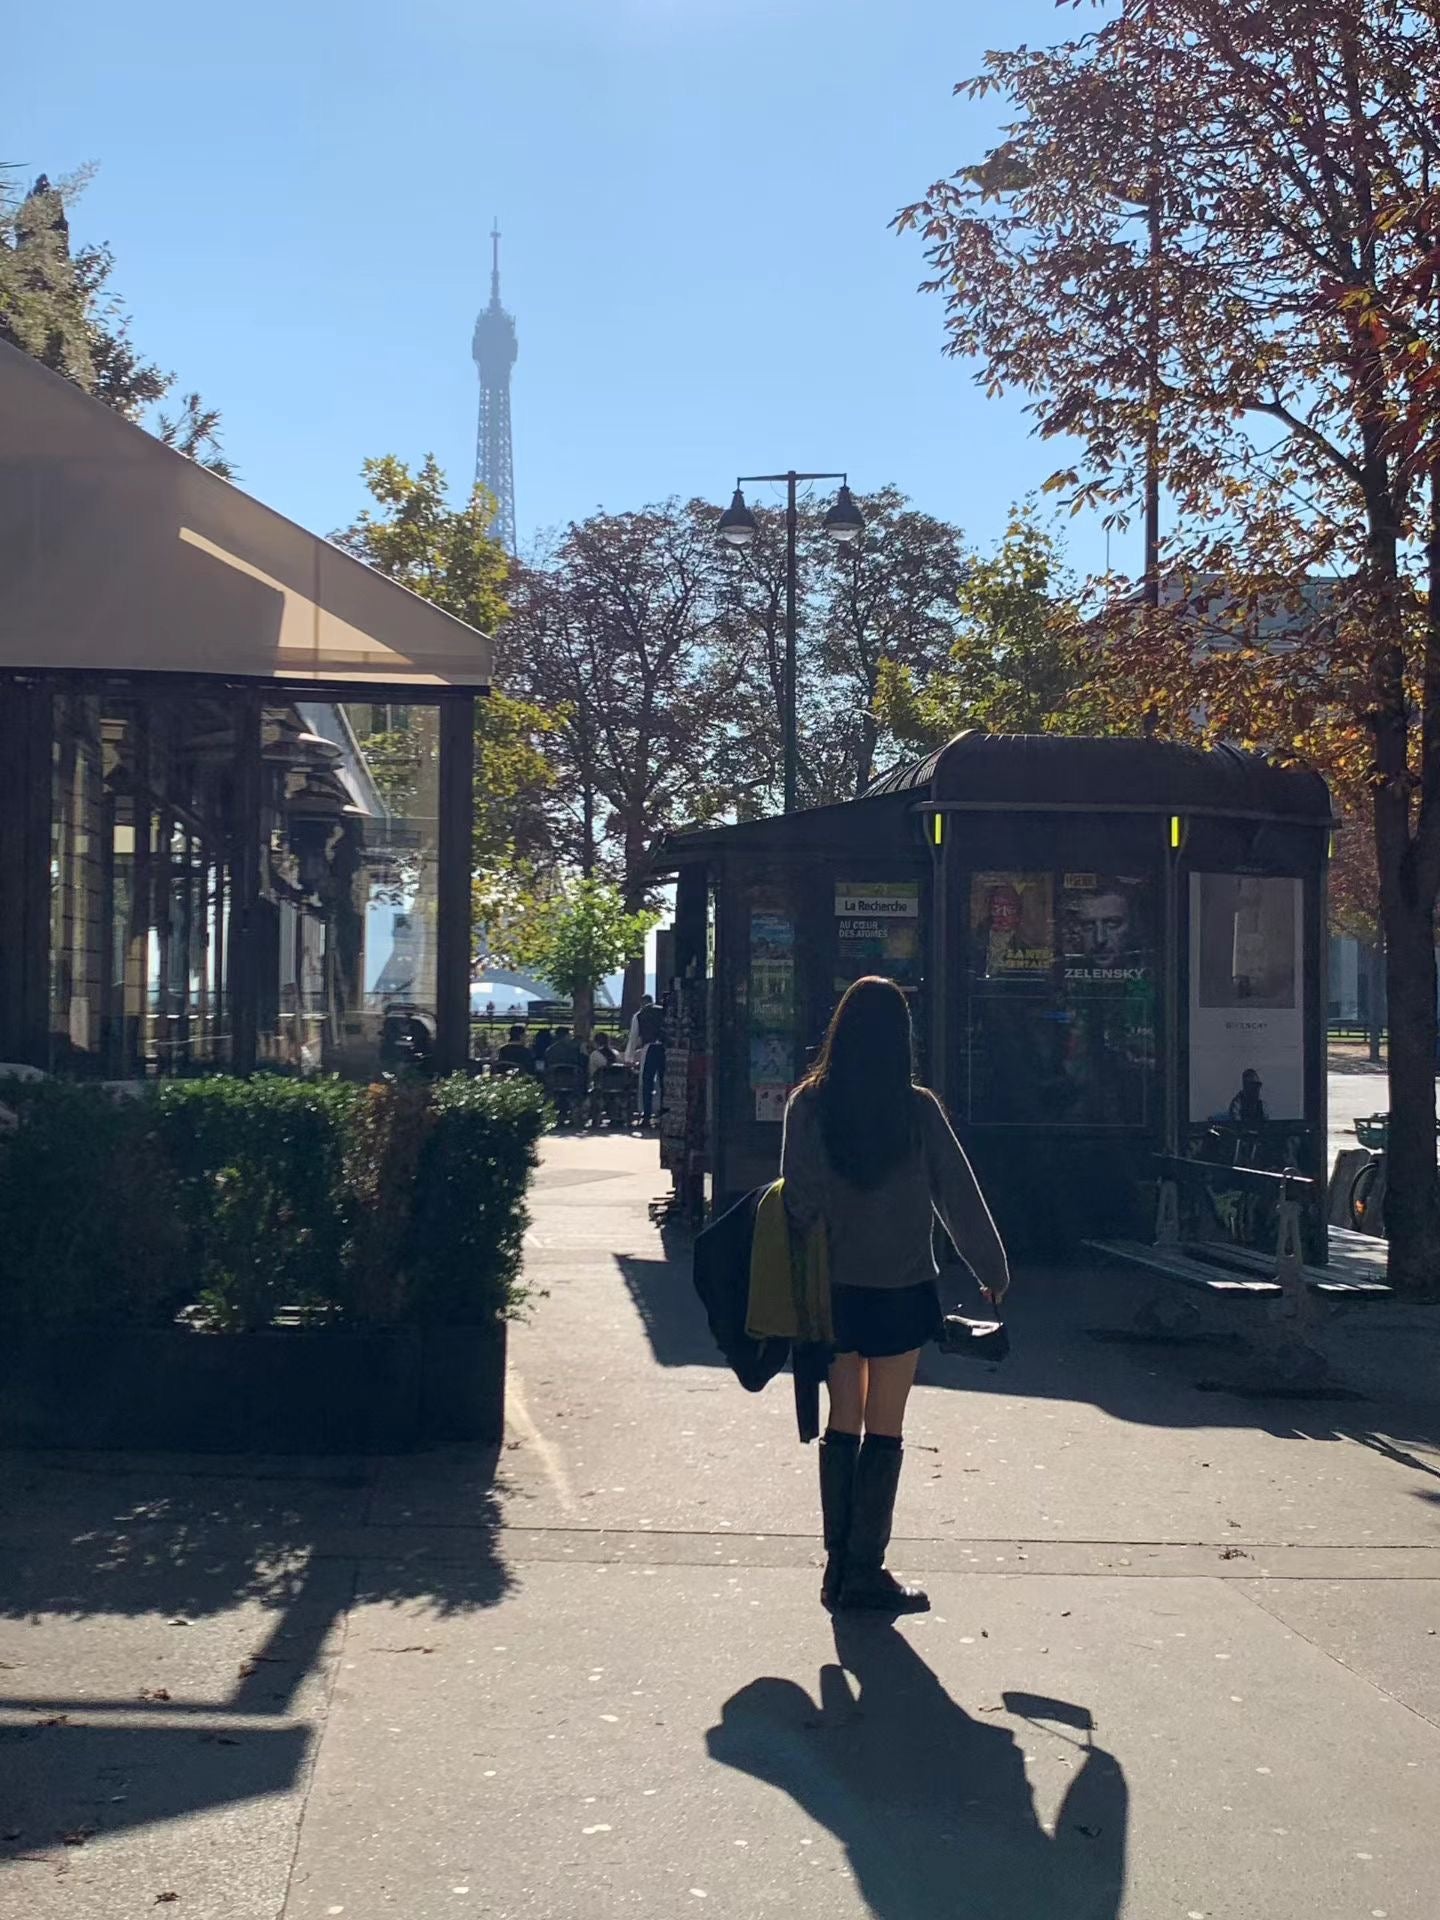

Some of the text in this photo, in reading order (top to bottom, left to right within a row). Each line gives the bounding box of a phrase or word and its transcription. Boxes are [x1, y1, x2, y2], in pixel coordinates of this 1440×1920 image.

[845, 900, 907, 912] La Recherche
[1063, 968, 1146, 979] ZELENSKY
